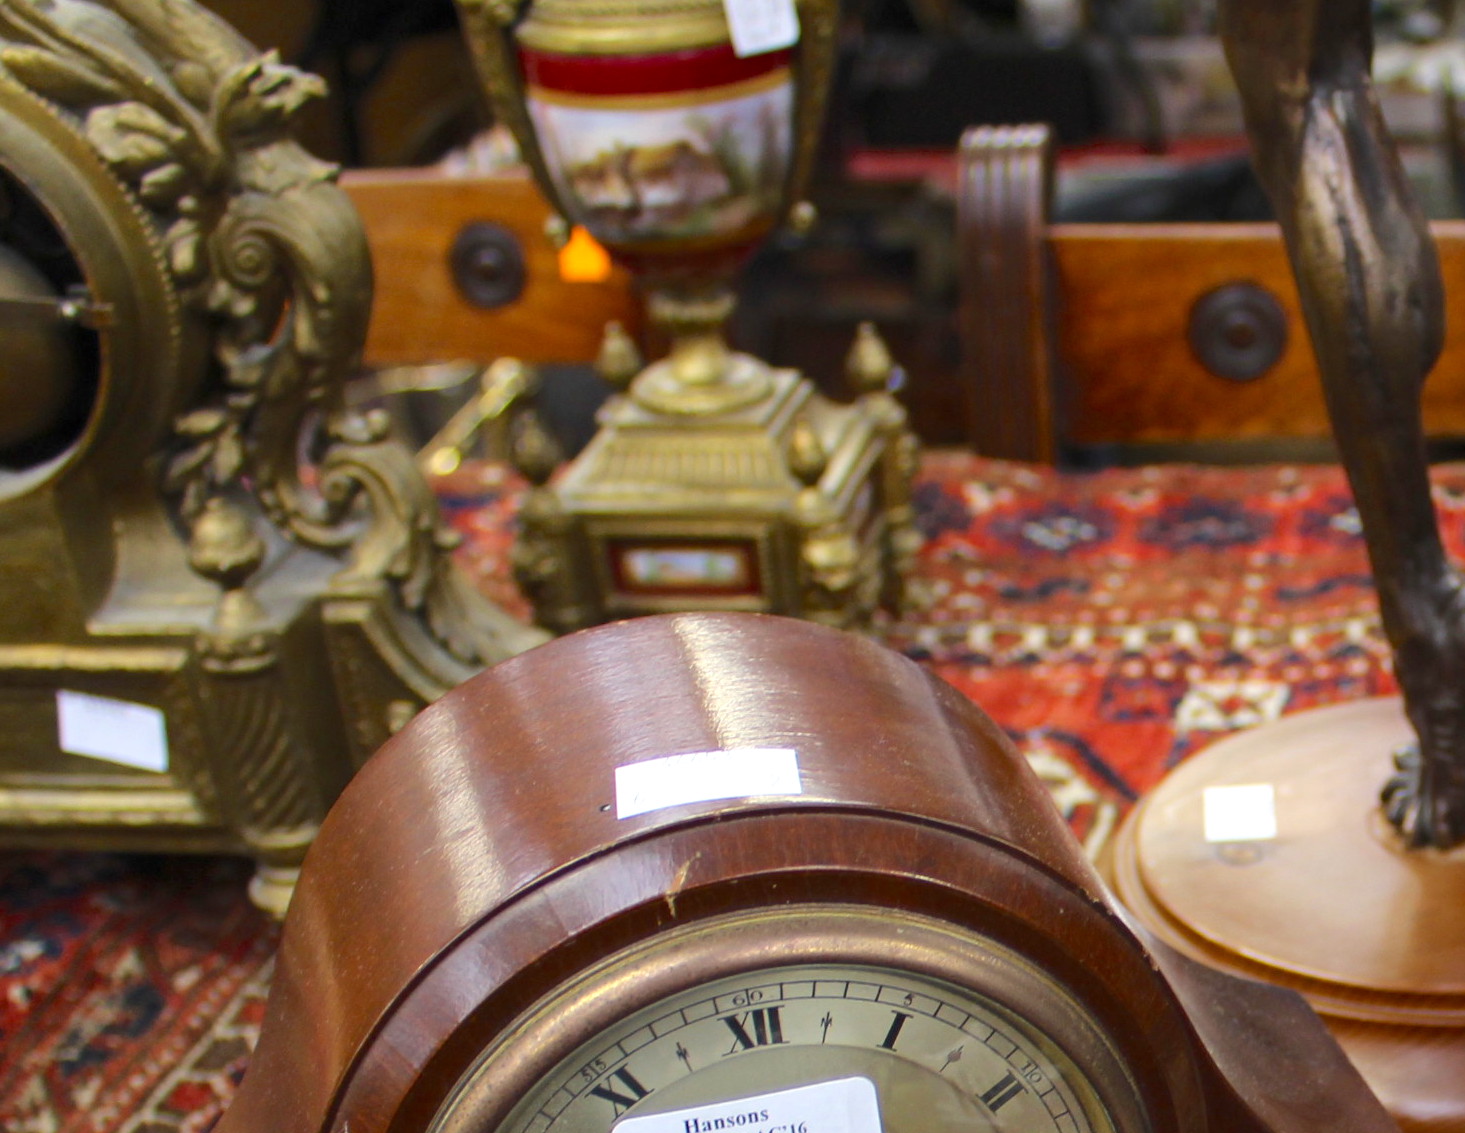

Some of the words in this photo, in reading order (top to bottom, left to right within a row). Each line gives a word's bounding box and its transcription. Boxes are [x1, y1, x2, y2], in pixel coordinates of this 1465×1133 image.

[732, 990, 763, 1006] 60
[717, 1004, 790, 1056] XII
[876, 1009, 914, 1052] I
[584, 1063, 654, 1122] XI
[976, 1069, 1029, 1116] II
